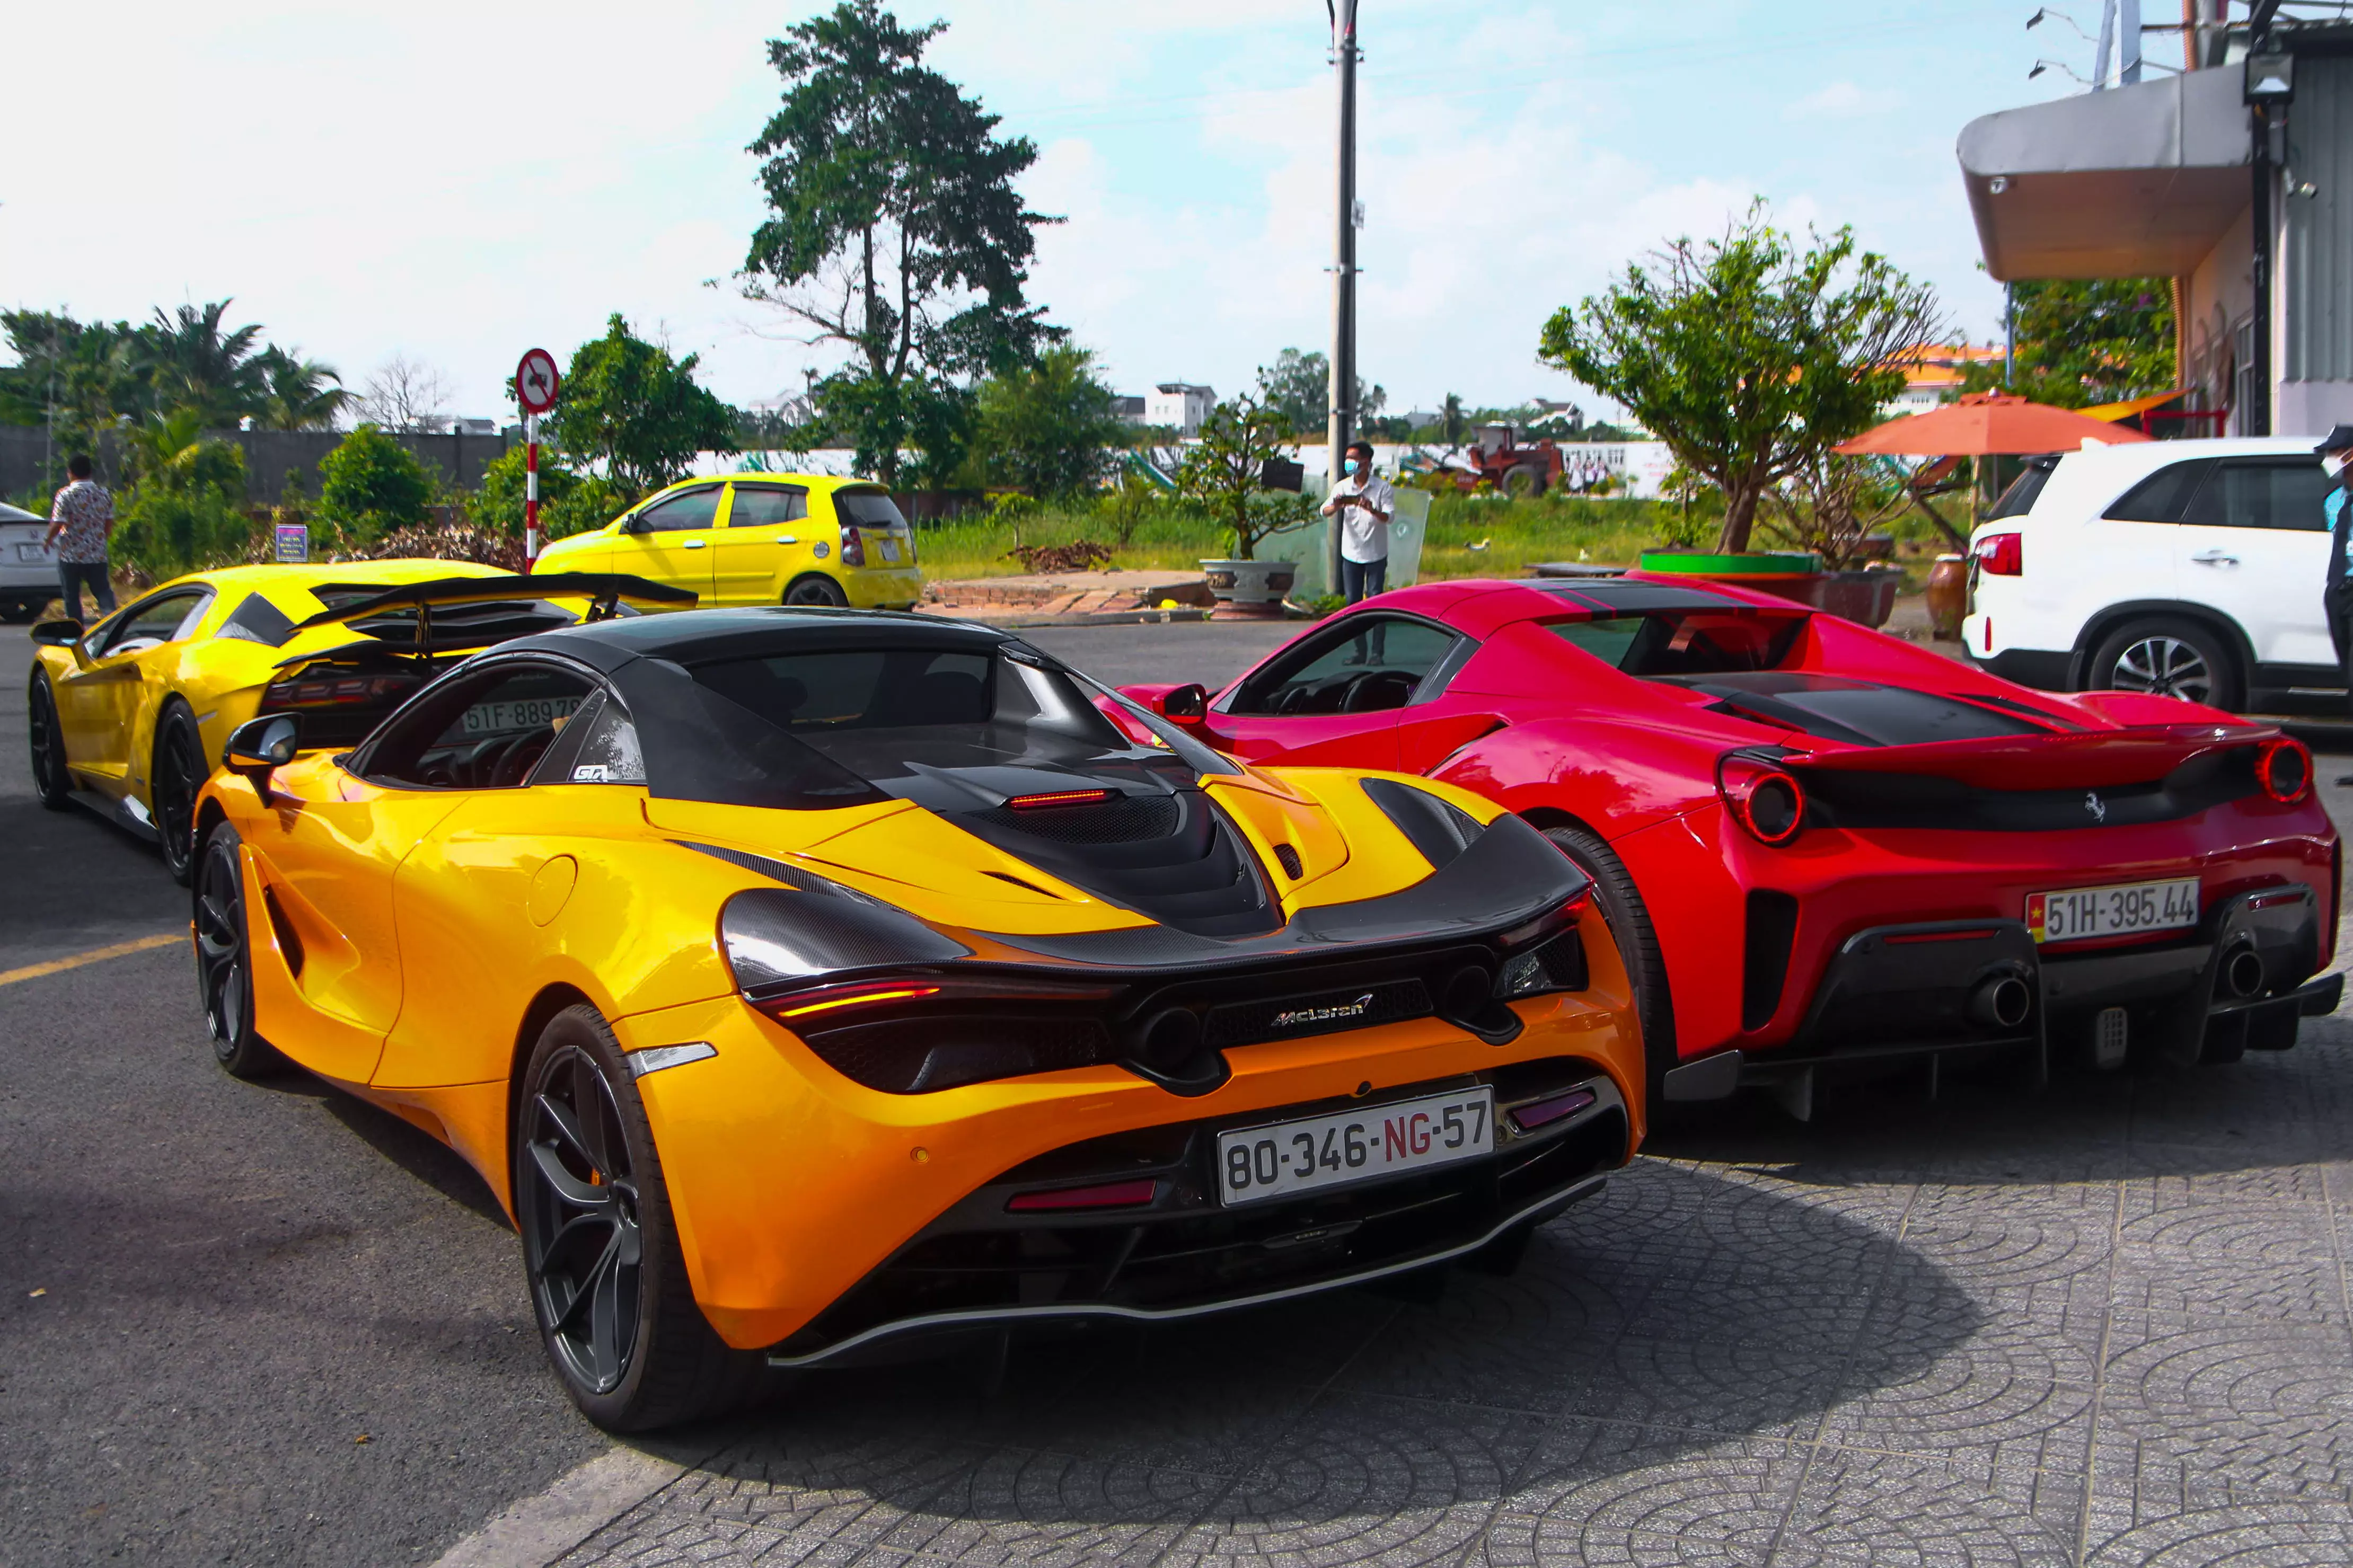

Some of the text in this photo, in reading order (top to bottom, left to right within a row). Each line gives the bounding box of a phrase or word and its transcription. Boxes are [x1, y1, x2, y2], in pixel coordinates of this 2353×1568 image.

[2048, 885, 2193, 935] 51H-395.44
[1271, 1003, 1365, 1026] McLaren
[1227, 1101, 1486, 1189] 80-346-NG-57
